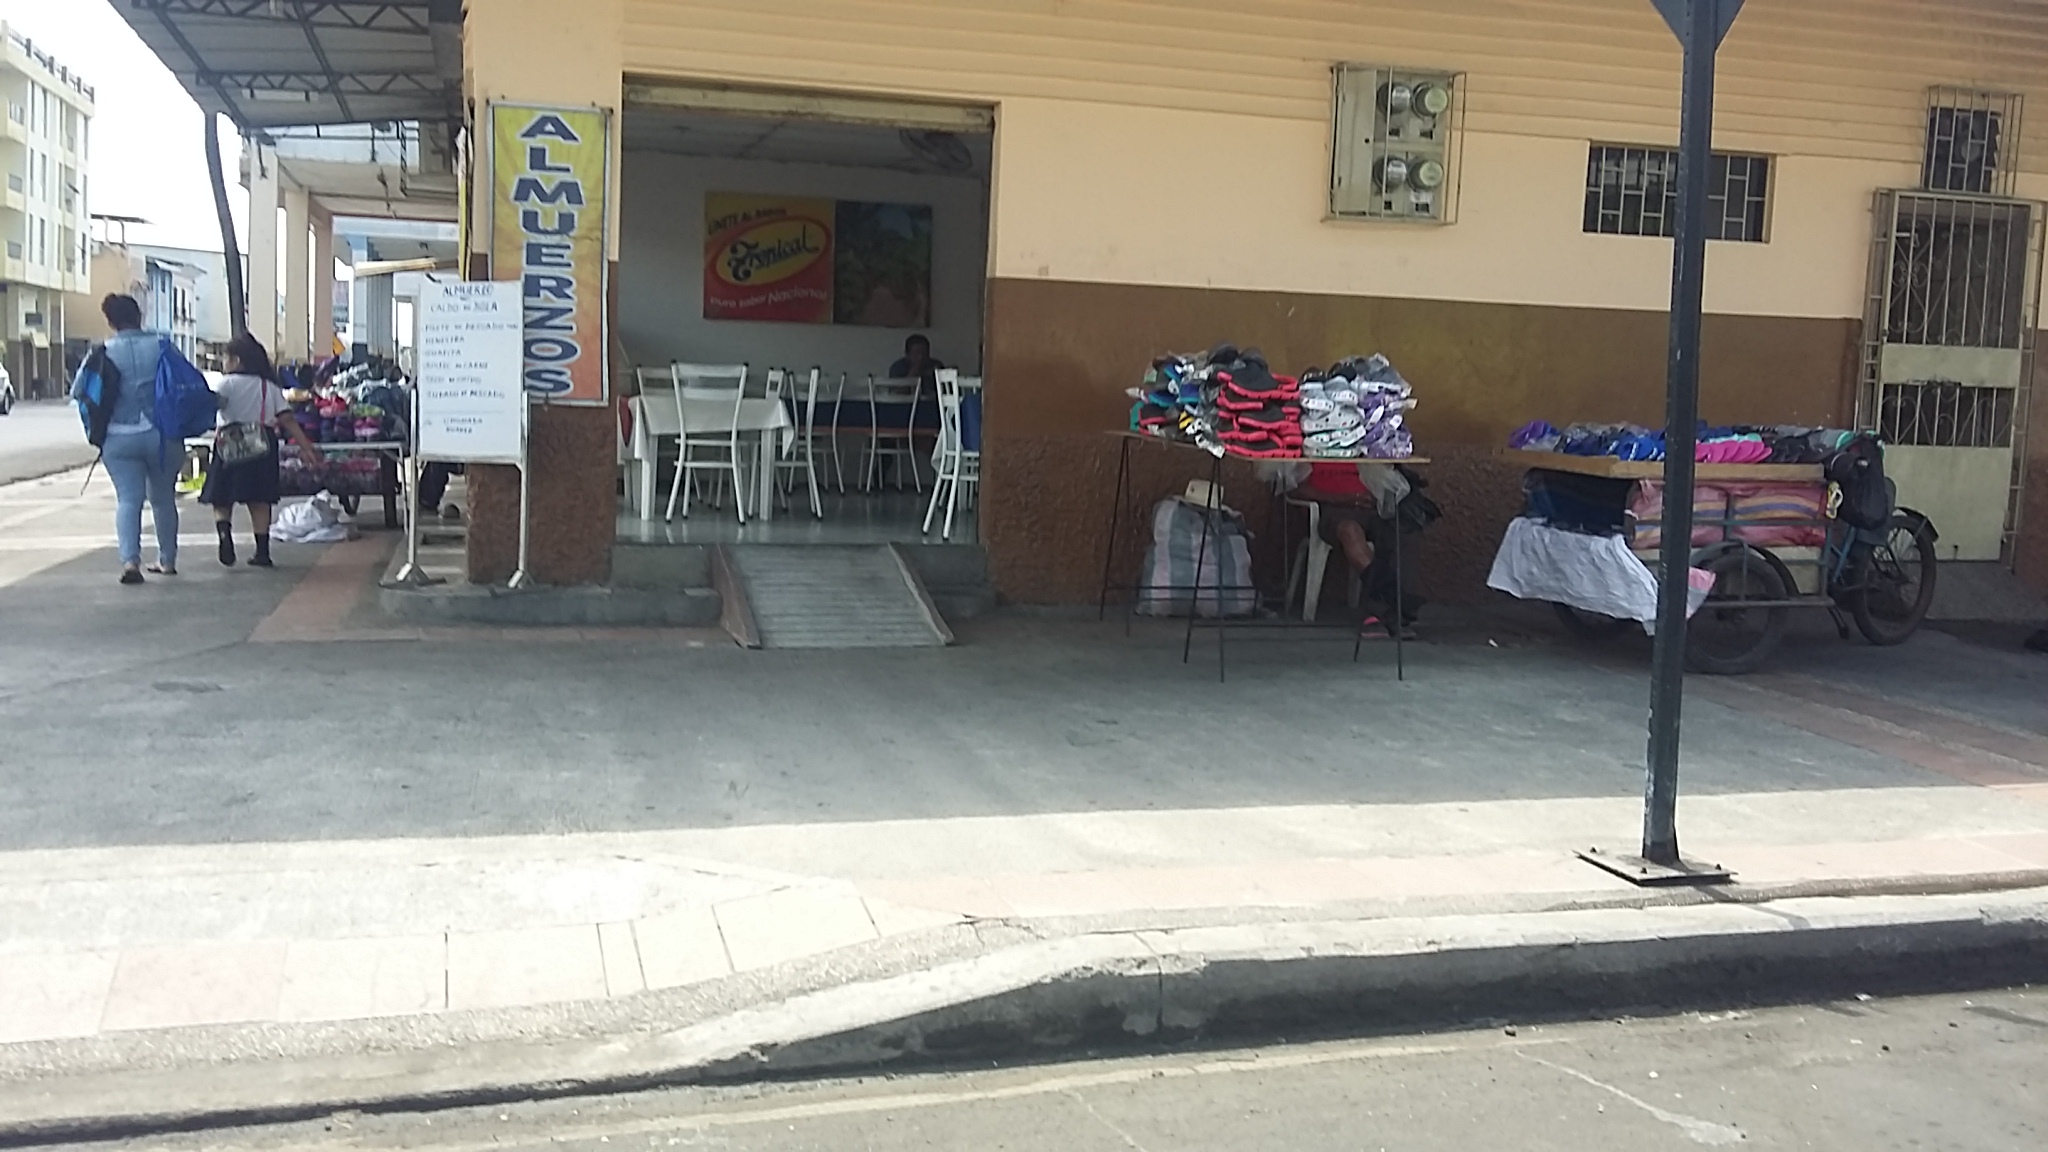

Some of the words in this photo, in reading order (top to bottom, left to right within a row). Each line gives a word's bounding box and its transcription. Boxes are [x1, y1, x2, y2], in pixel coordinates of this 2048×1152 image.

[513, 114, 584, 394] ALMUERZOS
[443, 284, 494, 297] ALMUERZO
[768, 287, 829, 307] Nacional
[430, 303, 459, 313] CALDO
